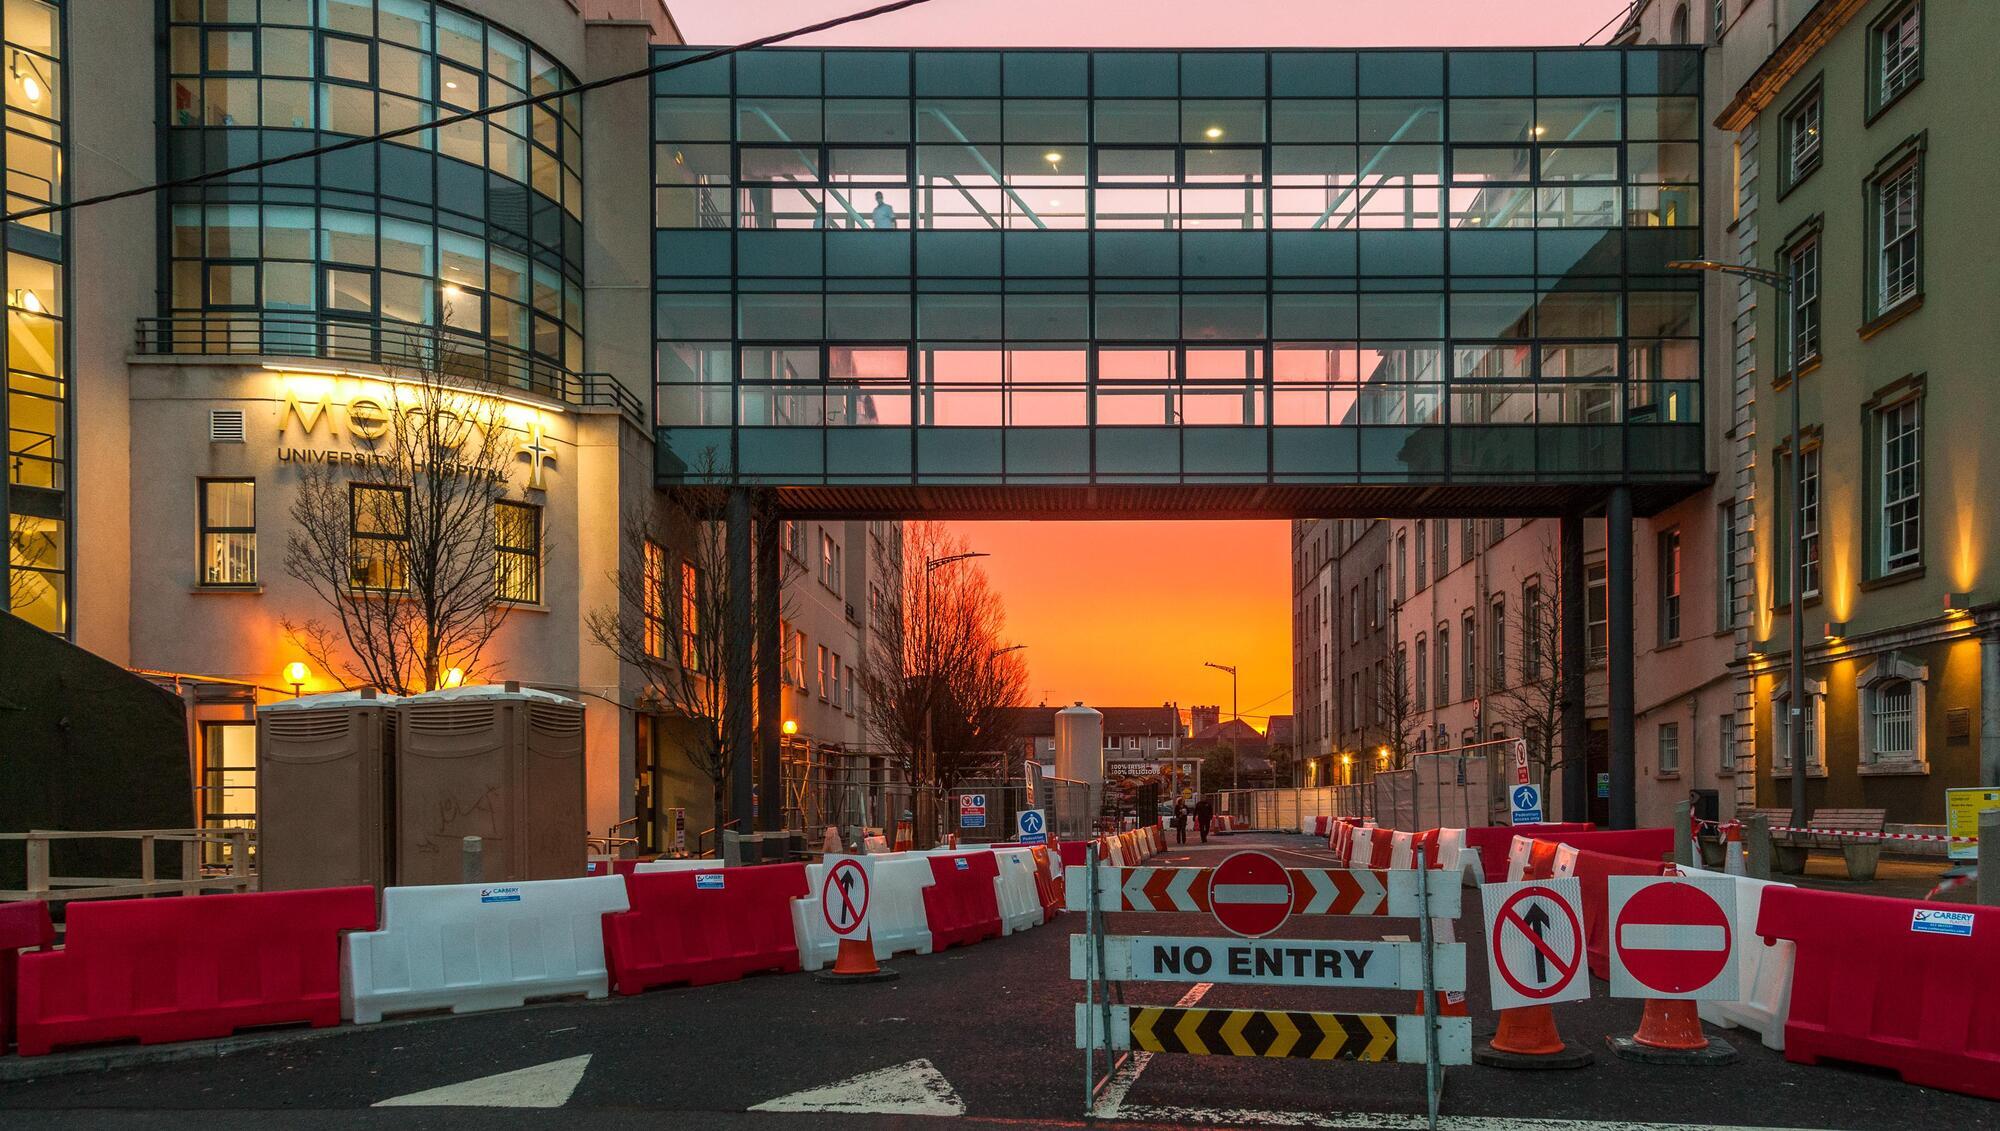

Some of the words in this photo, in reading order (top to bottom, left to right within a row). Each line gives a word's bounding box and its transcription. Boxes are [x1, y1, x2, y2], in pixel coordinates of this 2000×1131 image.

[277, 447, 399, 470] UNIVERSITY
[413, 460, 509, 483] HOSPITAL
[1933, 911, 1973, 921] CARBERY
[1153, 945, 1213, 975] NO
[1228, 946, 1375, 979] ENTRY
